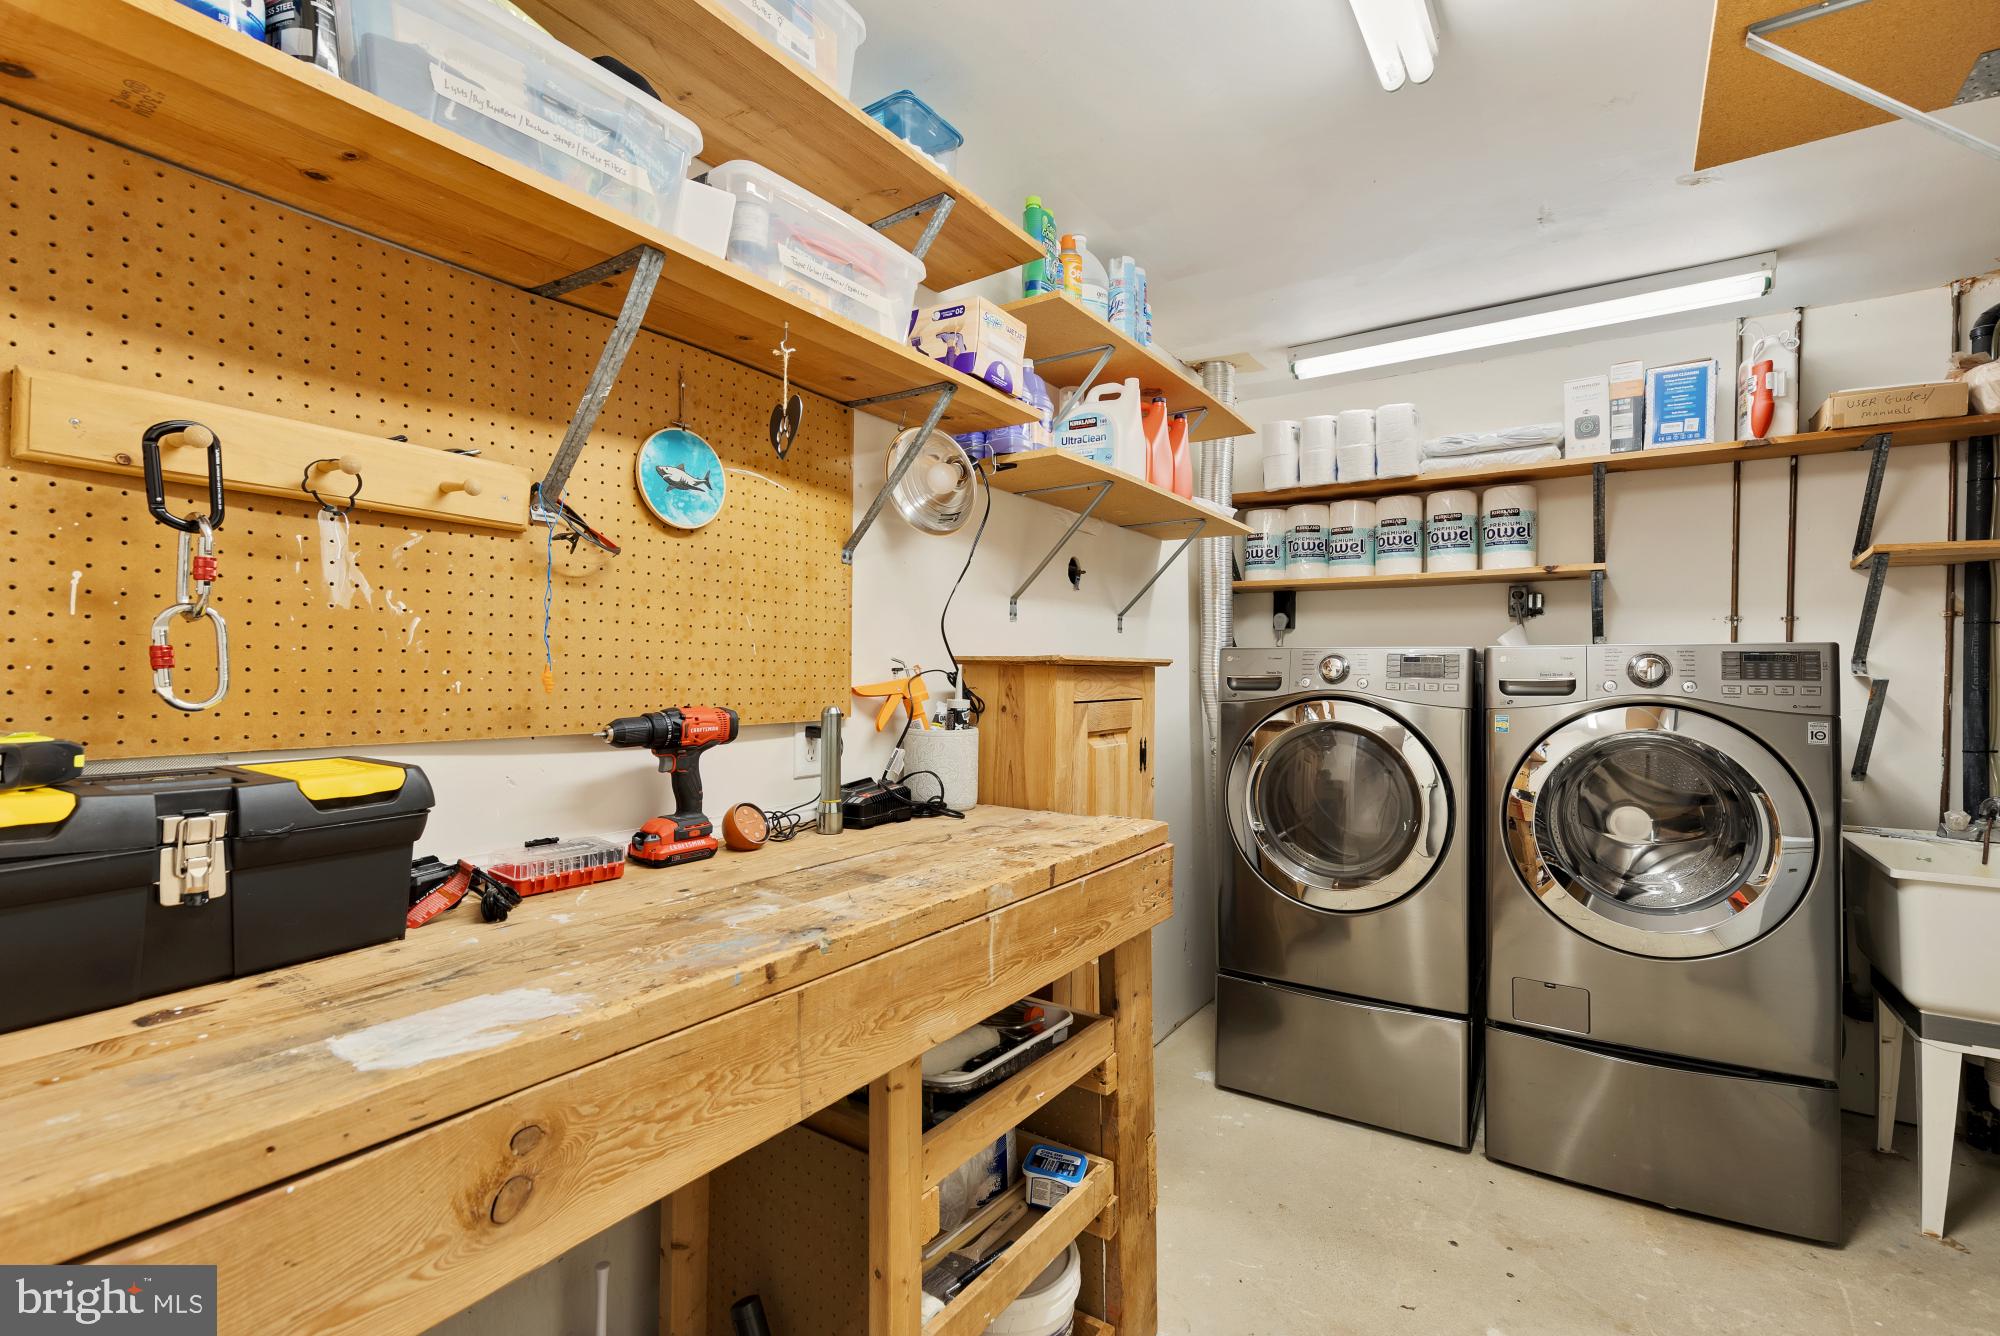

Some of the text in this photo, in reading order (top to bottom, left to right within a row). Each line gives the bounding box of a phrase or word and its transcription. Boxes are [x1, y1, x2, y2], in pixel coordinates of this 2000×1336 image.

[276, 1, 295, 13] STEEL
[1847, 397, 1877, 409] USER
[1070, 418, 1096, 427] KIRKLAND
[1061, 433, 1107, 446] UltraClean
[1490, 508, 1519, 516] KIRKLAND
[1482, 522, 1531, 540] Towel
[1288, 538, 1328, 552] Towel
[1245, 545, 1279, 559] owel
[669, 840, 706, 850] CRAFTSMAN
